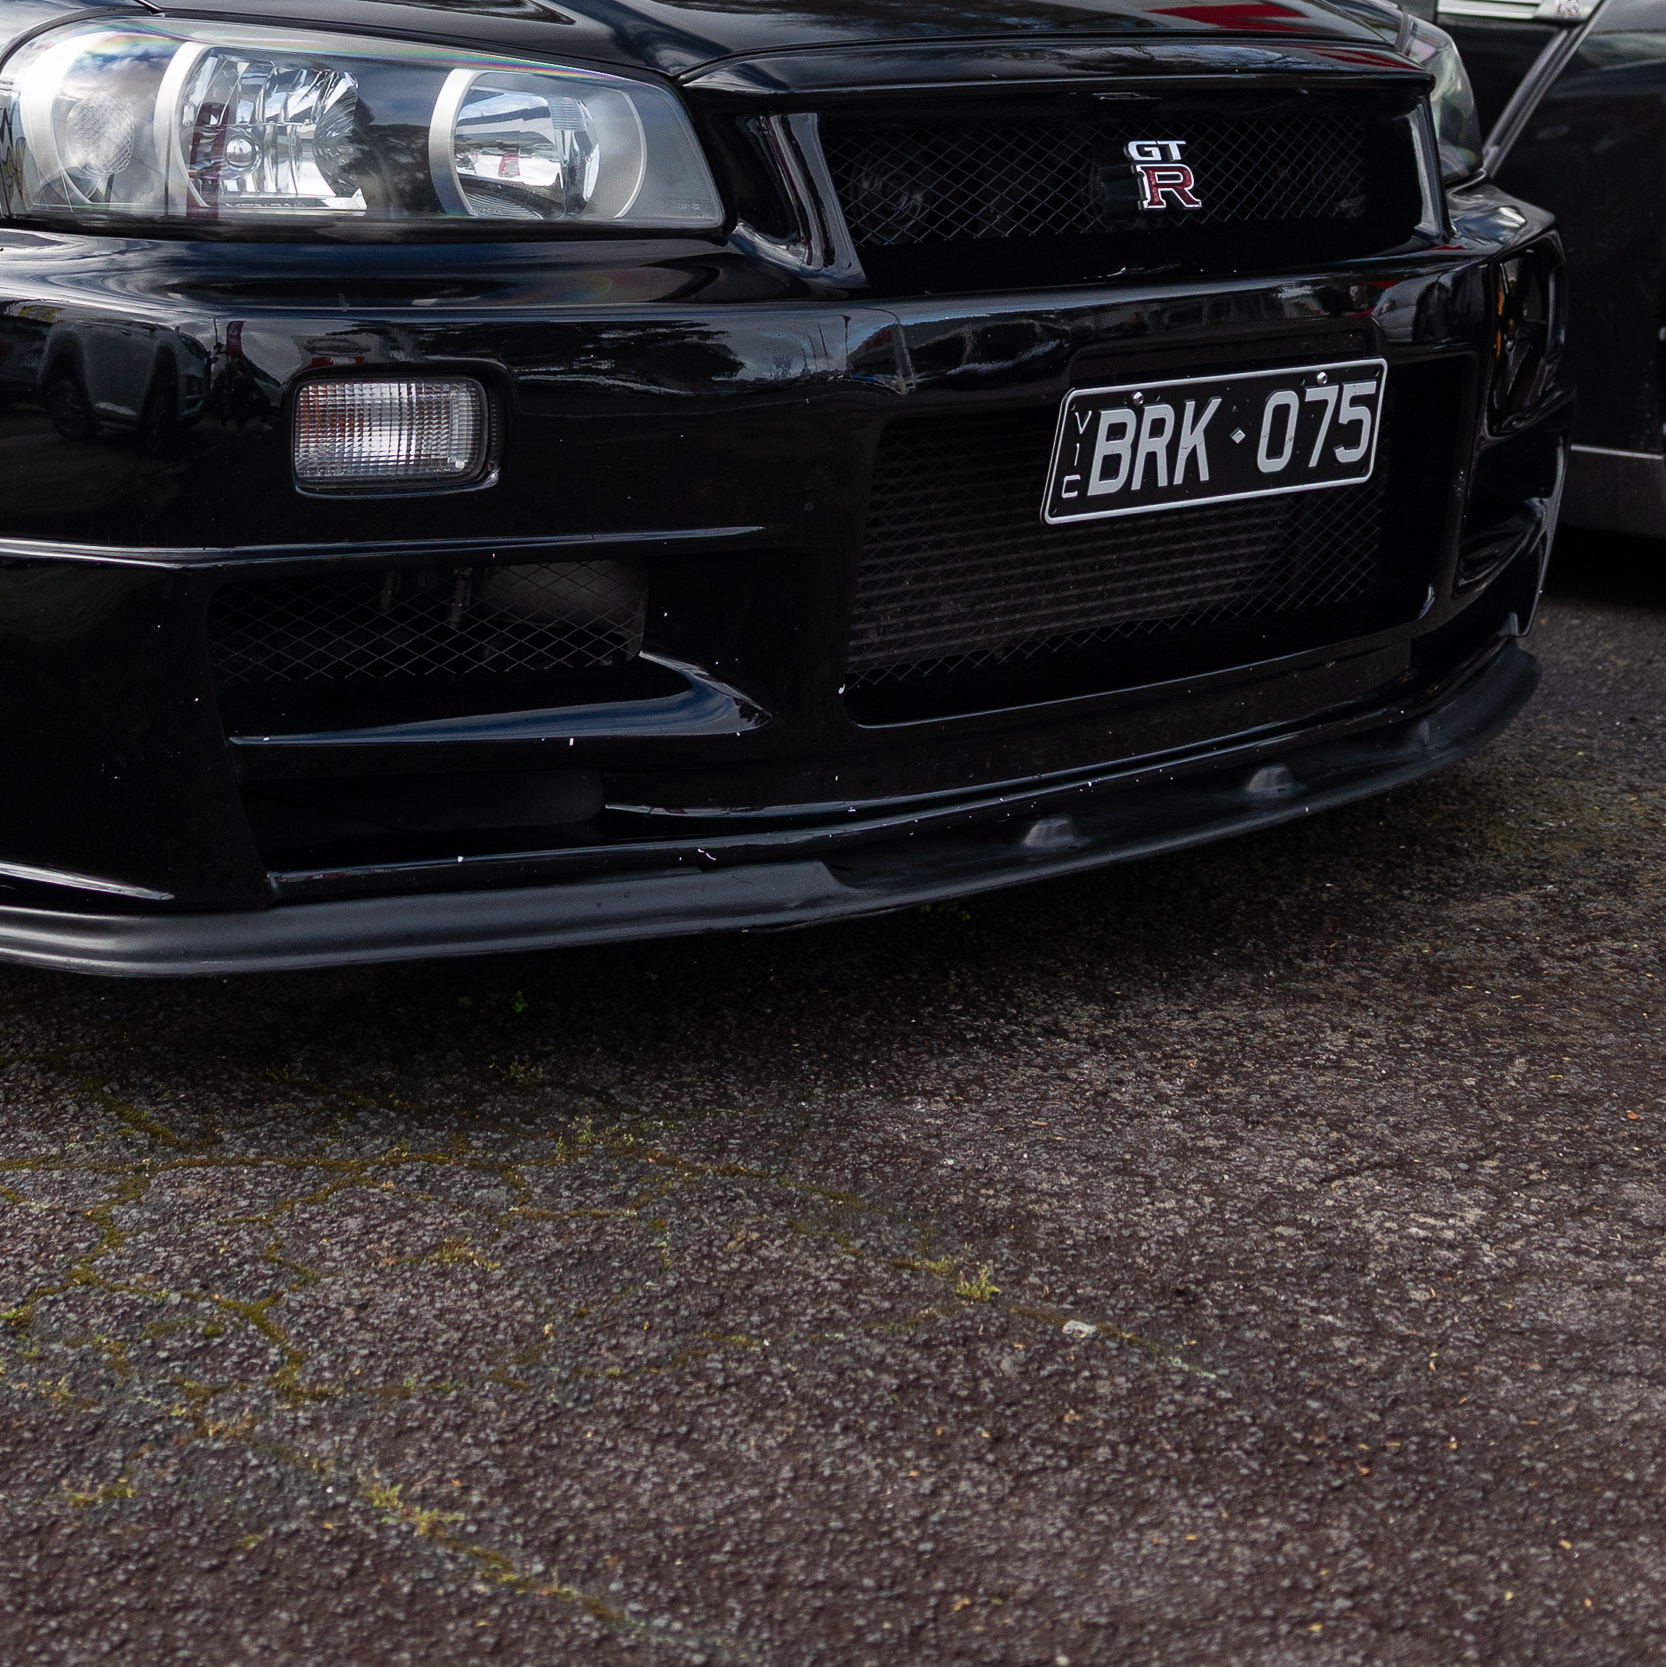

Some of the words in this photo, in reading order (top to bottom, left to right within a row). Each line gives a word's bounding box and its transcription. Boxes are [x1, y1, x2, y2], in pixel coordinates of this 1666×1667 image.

[1126, 140, 1187, 162] GT
[1132, 163, 1202, 210] R
[1087, 396, 1222, 496] BRK
[1257, 381, 1377, 473] 075
